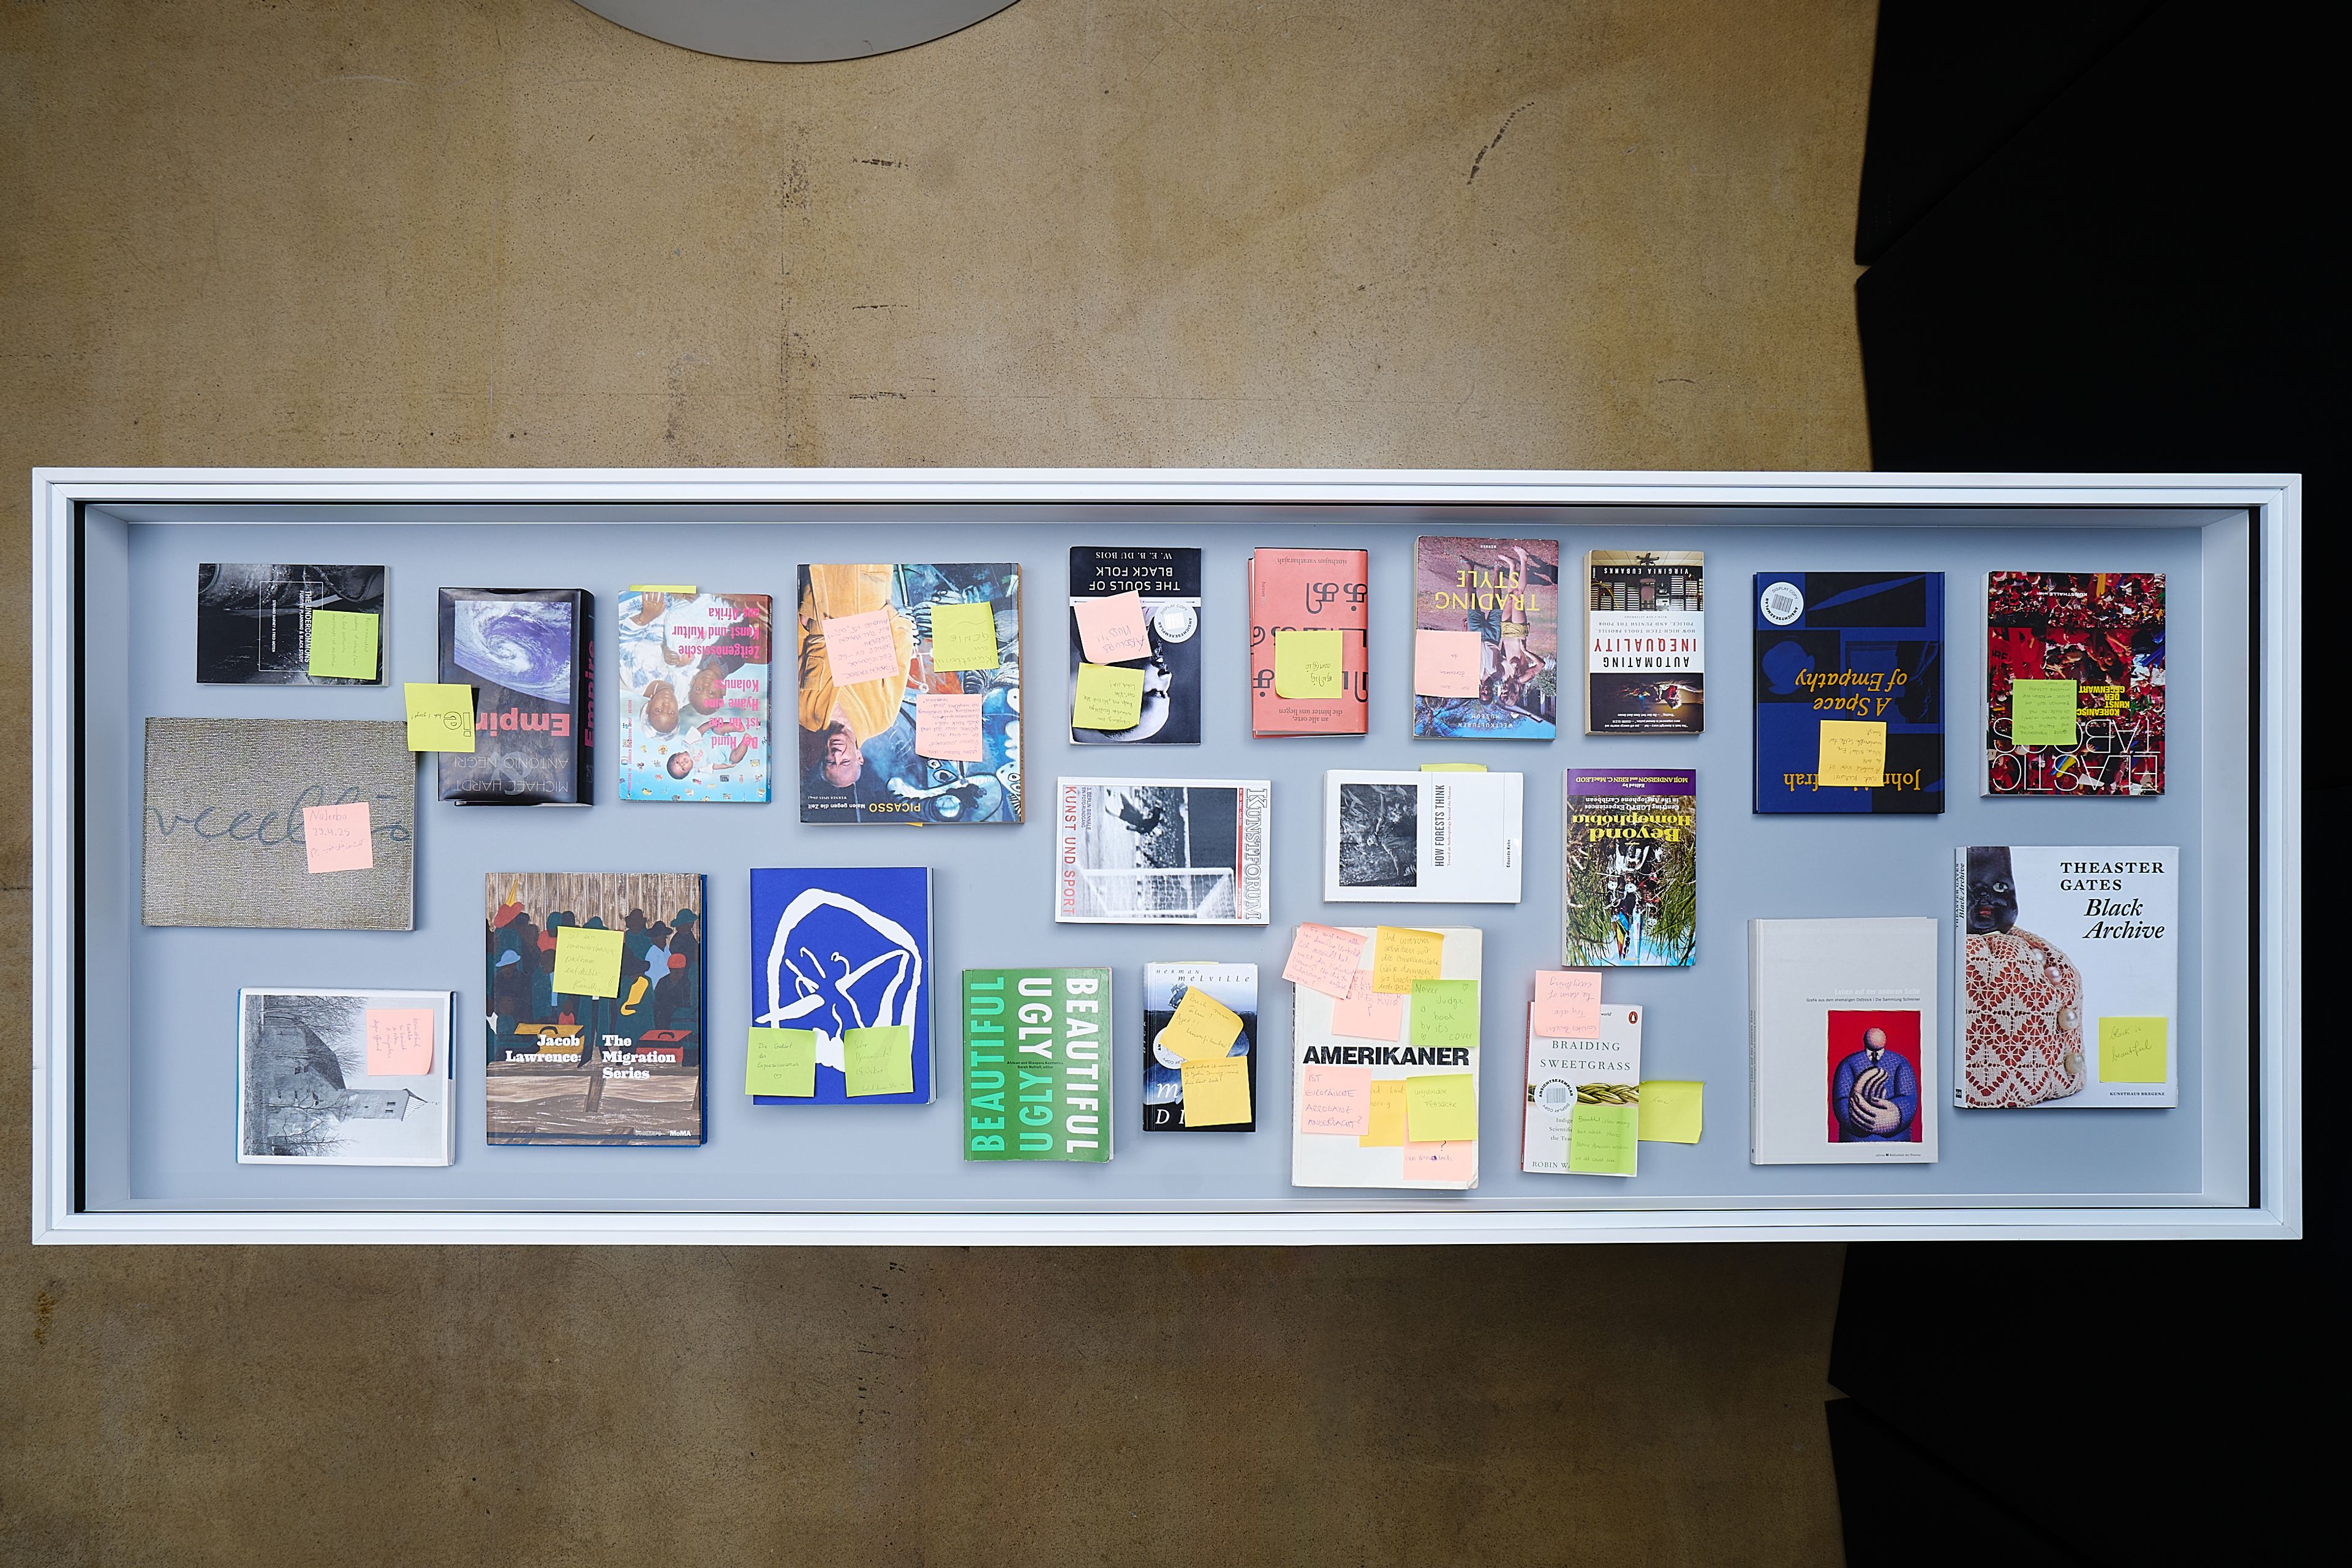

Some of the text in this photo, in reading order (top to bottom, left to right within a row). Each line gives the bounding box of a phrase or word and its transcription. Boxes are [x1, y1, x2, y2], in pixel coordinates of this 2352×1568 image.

[1277, 557, 1348, 566] sinthujan varatharajah
[1095, 566, 1173, 577] BLACK FOLK
[1088, 581, 1181, 591] THE SOULS OF
[1456, 570, 1519, 589] STYLE
[1434, 591, 1540, 611] TRADING
[709, 607, 760, 620] aus Afrika
[1765, 597, 1798, 621] ANSICHTSEXEMPLAR
[672, 625, 760, 639] Kunst und Kultur
[1158, 617, 1193, 638] ANSICHTSEXEMPLAR
[950, 631, 989, 642] GENIE
[678, 643, 760, 659] Zeitgenössische
[1594, 638, 1697, 652] INEQUALITY
[1602, 657, 1689, 668] AUTOMATING
[713, 679, 759, 692] Kolanuss
[1795, 668, 1908, 693] of Empathy
[704, 696, 759, 711] Hyäne eine
[1812, 693, 1892, 717] A Space
[475, 707, 570, 737] Empir
[709, 717, 759, 729] ist für die
[711, 736, 758, 749] Der Hund
[454, 756, 569, 769] ANTONIO NEGRI
[1992, 754, 2160, 791] ELASTIC
[454, 780, 568, 793] MICHAEL HARDT
[869, 802, 921, 813] PICASSO
[1434, 785, 1444, 867] HOW FORESTS THINK
[1572, 812, 1691, 826] Homophobia
[1589, 824, 1680, 842] Beyond
[1063, 786, 1077, 915] KUNST UND SPORT
[1245, 788, 1268, 920] KUNSTFORUM
[2060, 862, 2165, 874] THEASTER
[2060, 879, 2122, 891] GATES
[2084, 898, 2143, 917] Black
[2082, 920, 2165, 940] Archive
[1415, 983, 1438, 994] Never
[1436, 996, 1464, 1009] Judge
[1018, 977, 1053, 1060] UGLY
[1433, 1011, 1455, 1021] book
[1420, 1020, 1431, 1031] by
[536, 1034, 581, 1047] Jacob
[602, 1035, 632, 1047] The
[1552, 1040, 1621, 1051] BRAIDING
[505, 1050, 581, 1063] Lawrence:
[602, 1050, 676, 1065] Migration
[1302, 1046, 1470, 1066] AMERIKANER
[970, 976, 1005, 1152] BEAUTIFUL
[1066, 978, 1099, 1153] BEAUTIFUL
[1540, 1059, 1630, 1071] SWEETGRASS
[602, 1066, 650, 1080] Series
[1308, 1074, 1322, 1083] IST
[1539, 1078, 1574, 1098] ANSICHTSEXEMPLAR
[1019, 1069, 1054, 1152] UGLY
